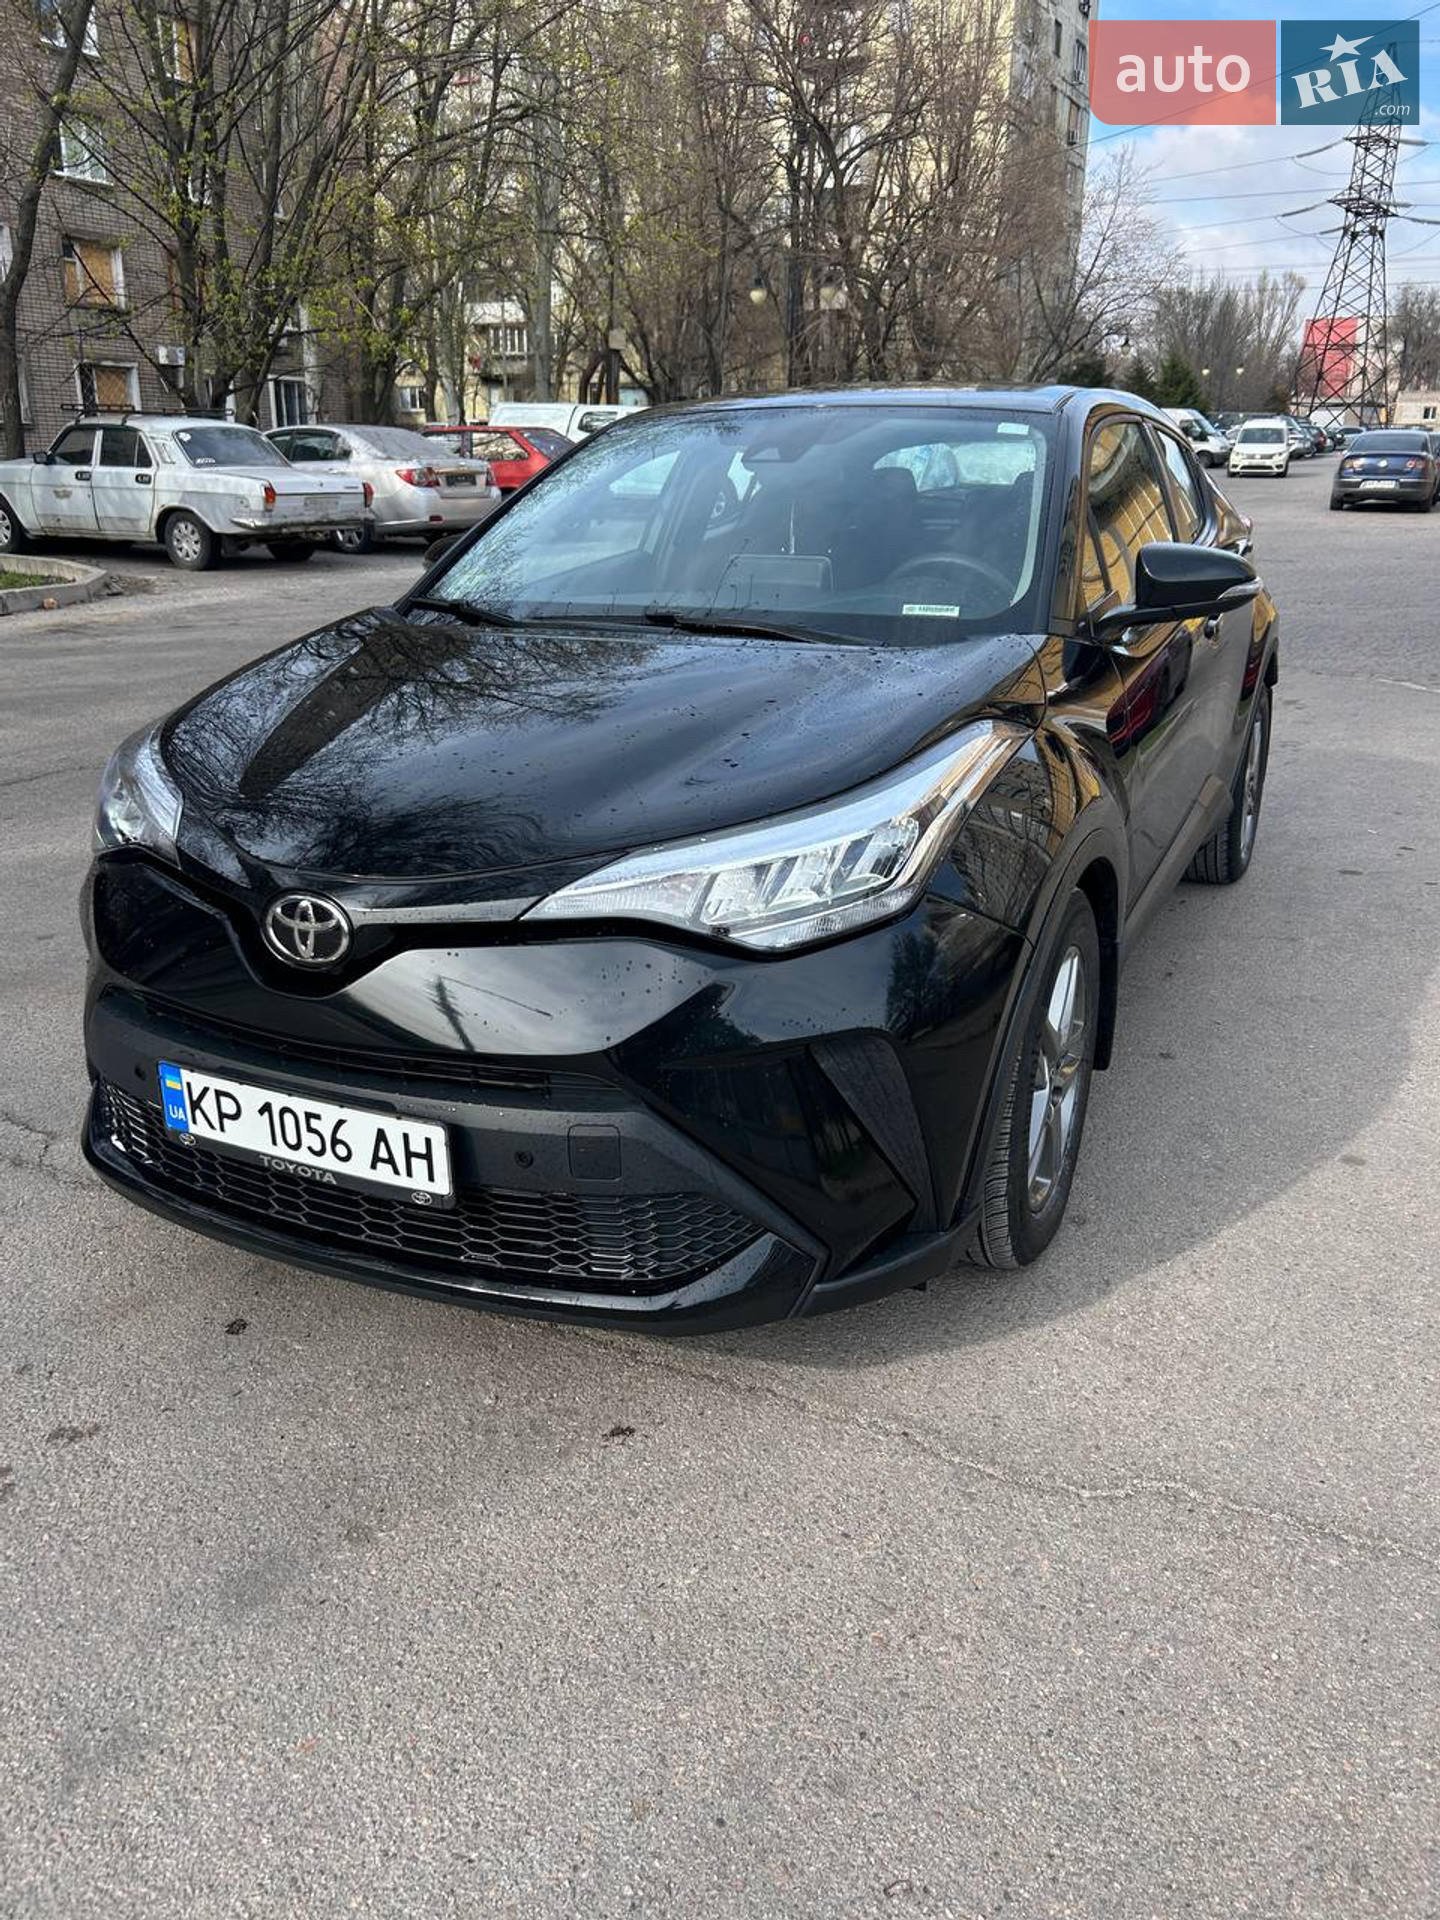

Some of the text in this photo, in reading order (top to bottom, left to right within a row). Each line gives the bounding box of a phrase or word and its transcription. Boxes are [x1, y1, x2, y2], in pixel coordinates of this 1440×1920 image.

[169, 1104, 186, 1121] UA
[186, 1081, 435, 1183] KP 1056 AH
[259, 1154, 337, 1185] TOYOTA
